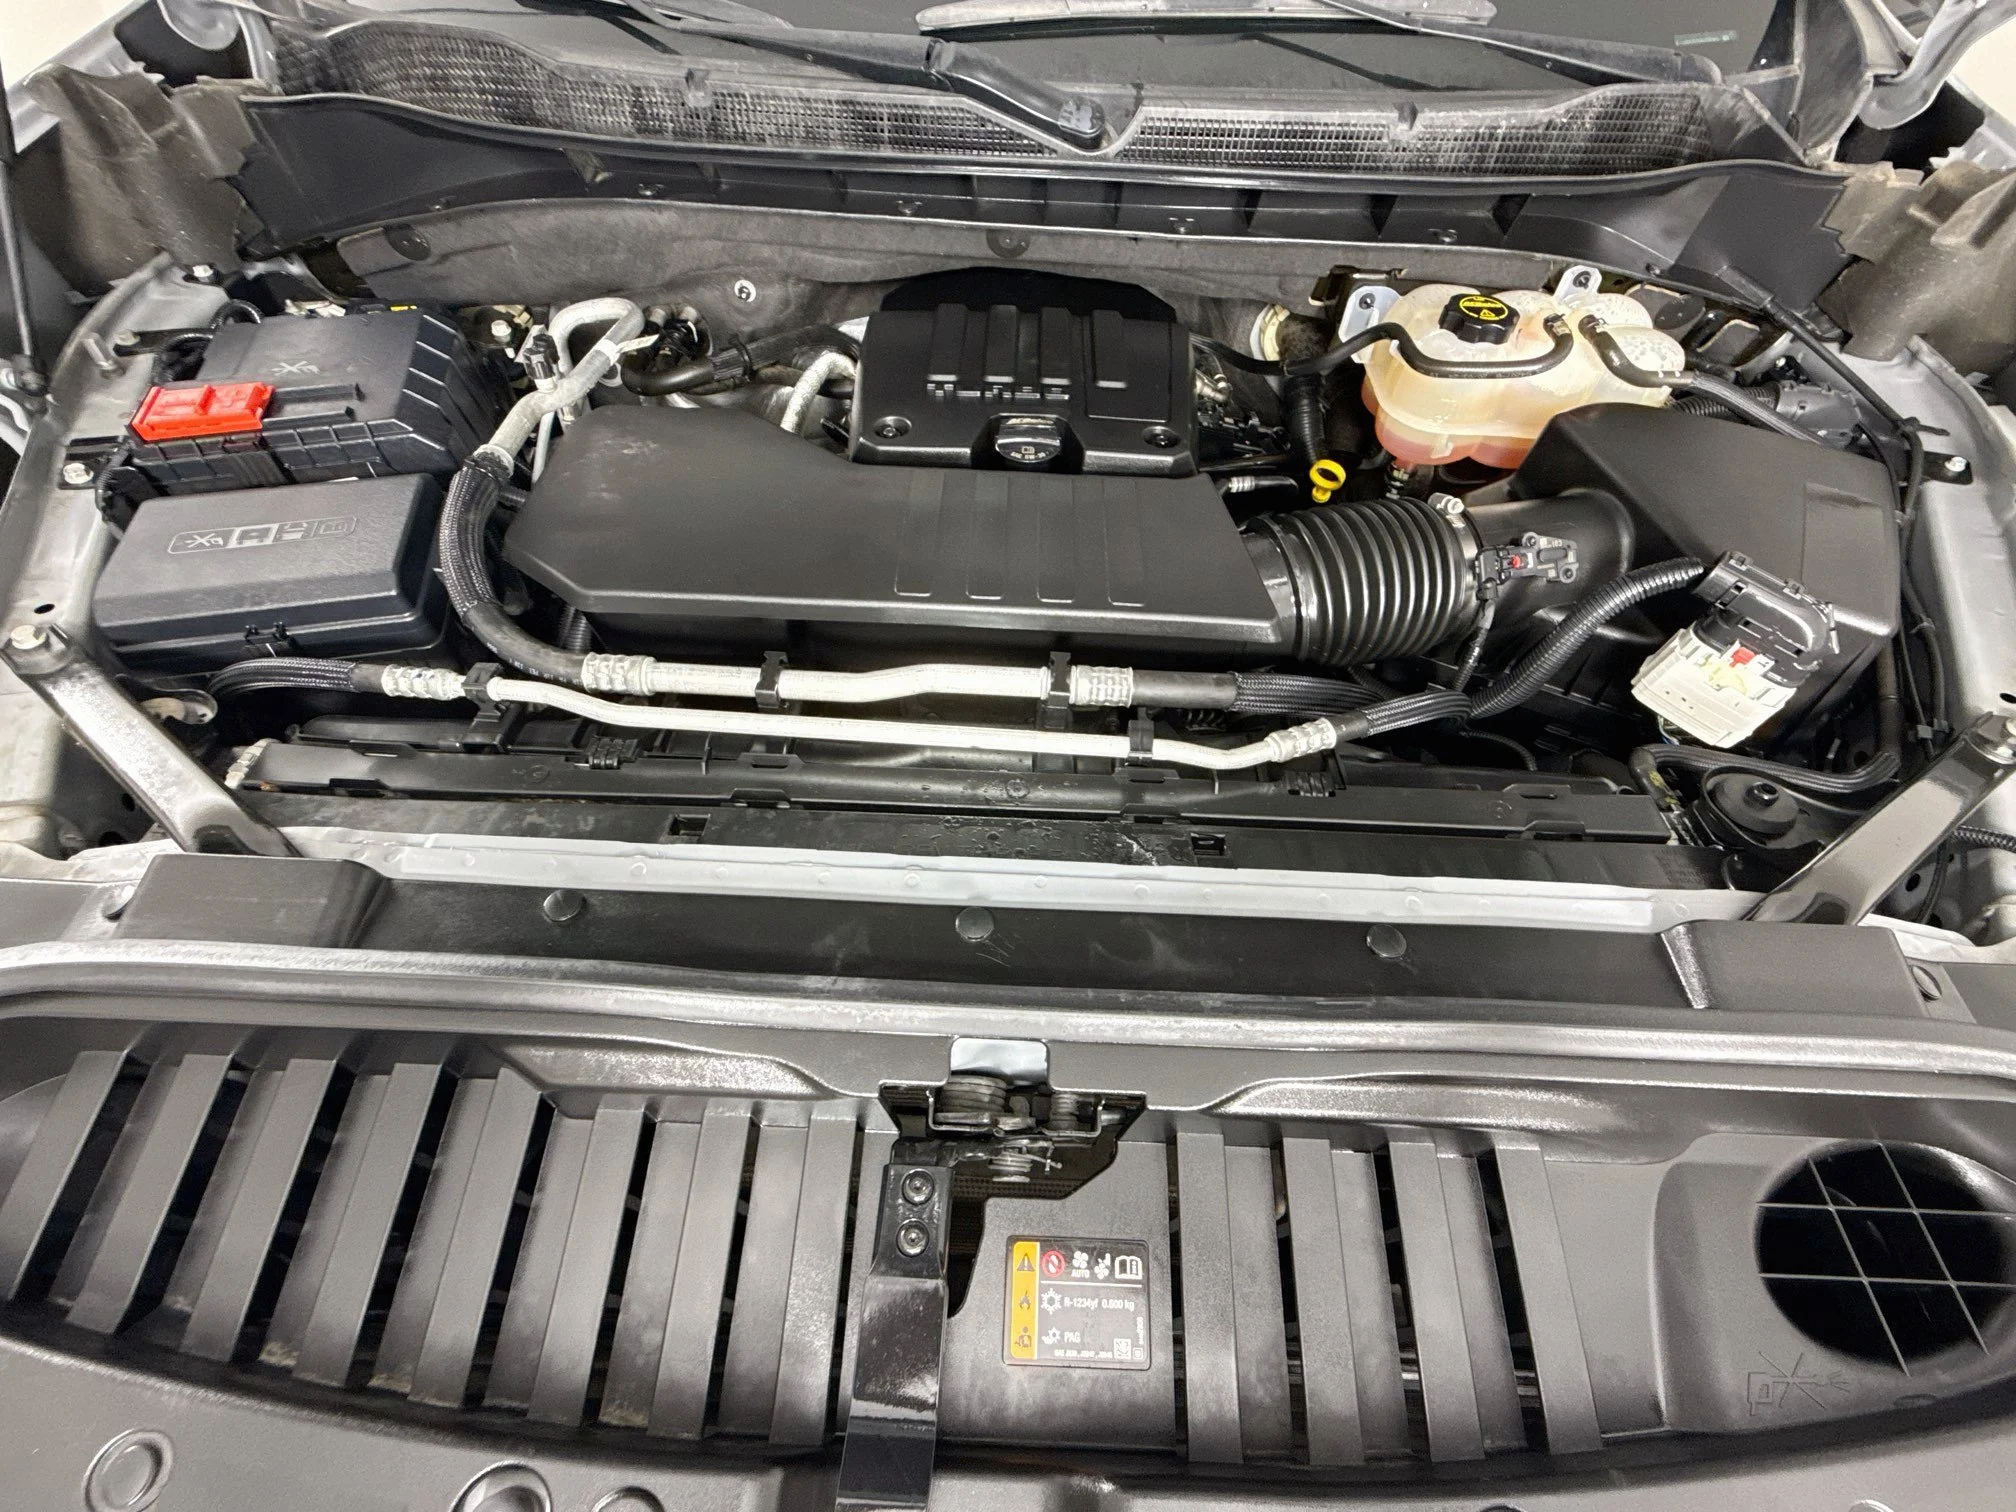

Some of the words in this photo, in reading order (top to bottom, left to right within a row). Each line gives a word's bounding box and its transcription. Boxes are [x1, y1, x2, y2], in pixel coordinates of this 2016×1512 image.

[1071, 1269, 1090, 1279] AUTO
[1064, 1297, 1099, 1311] R-1234yf
[1124, 1300, 1135, 1312] kg
[1064, 1331, 1081, 1344] PAG
